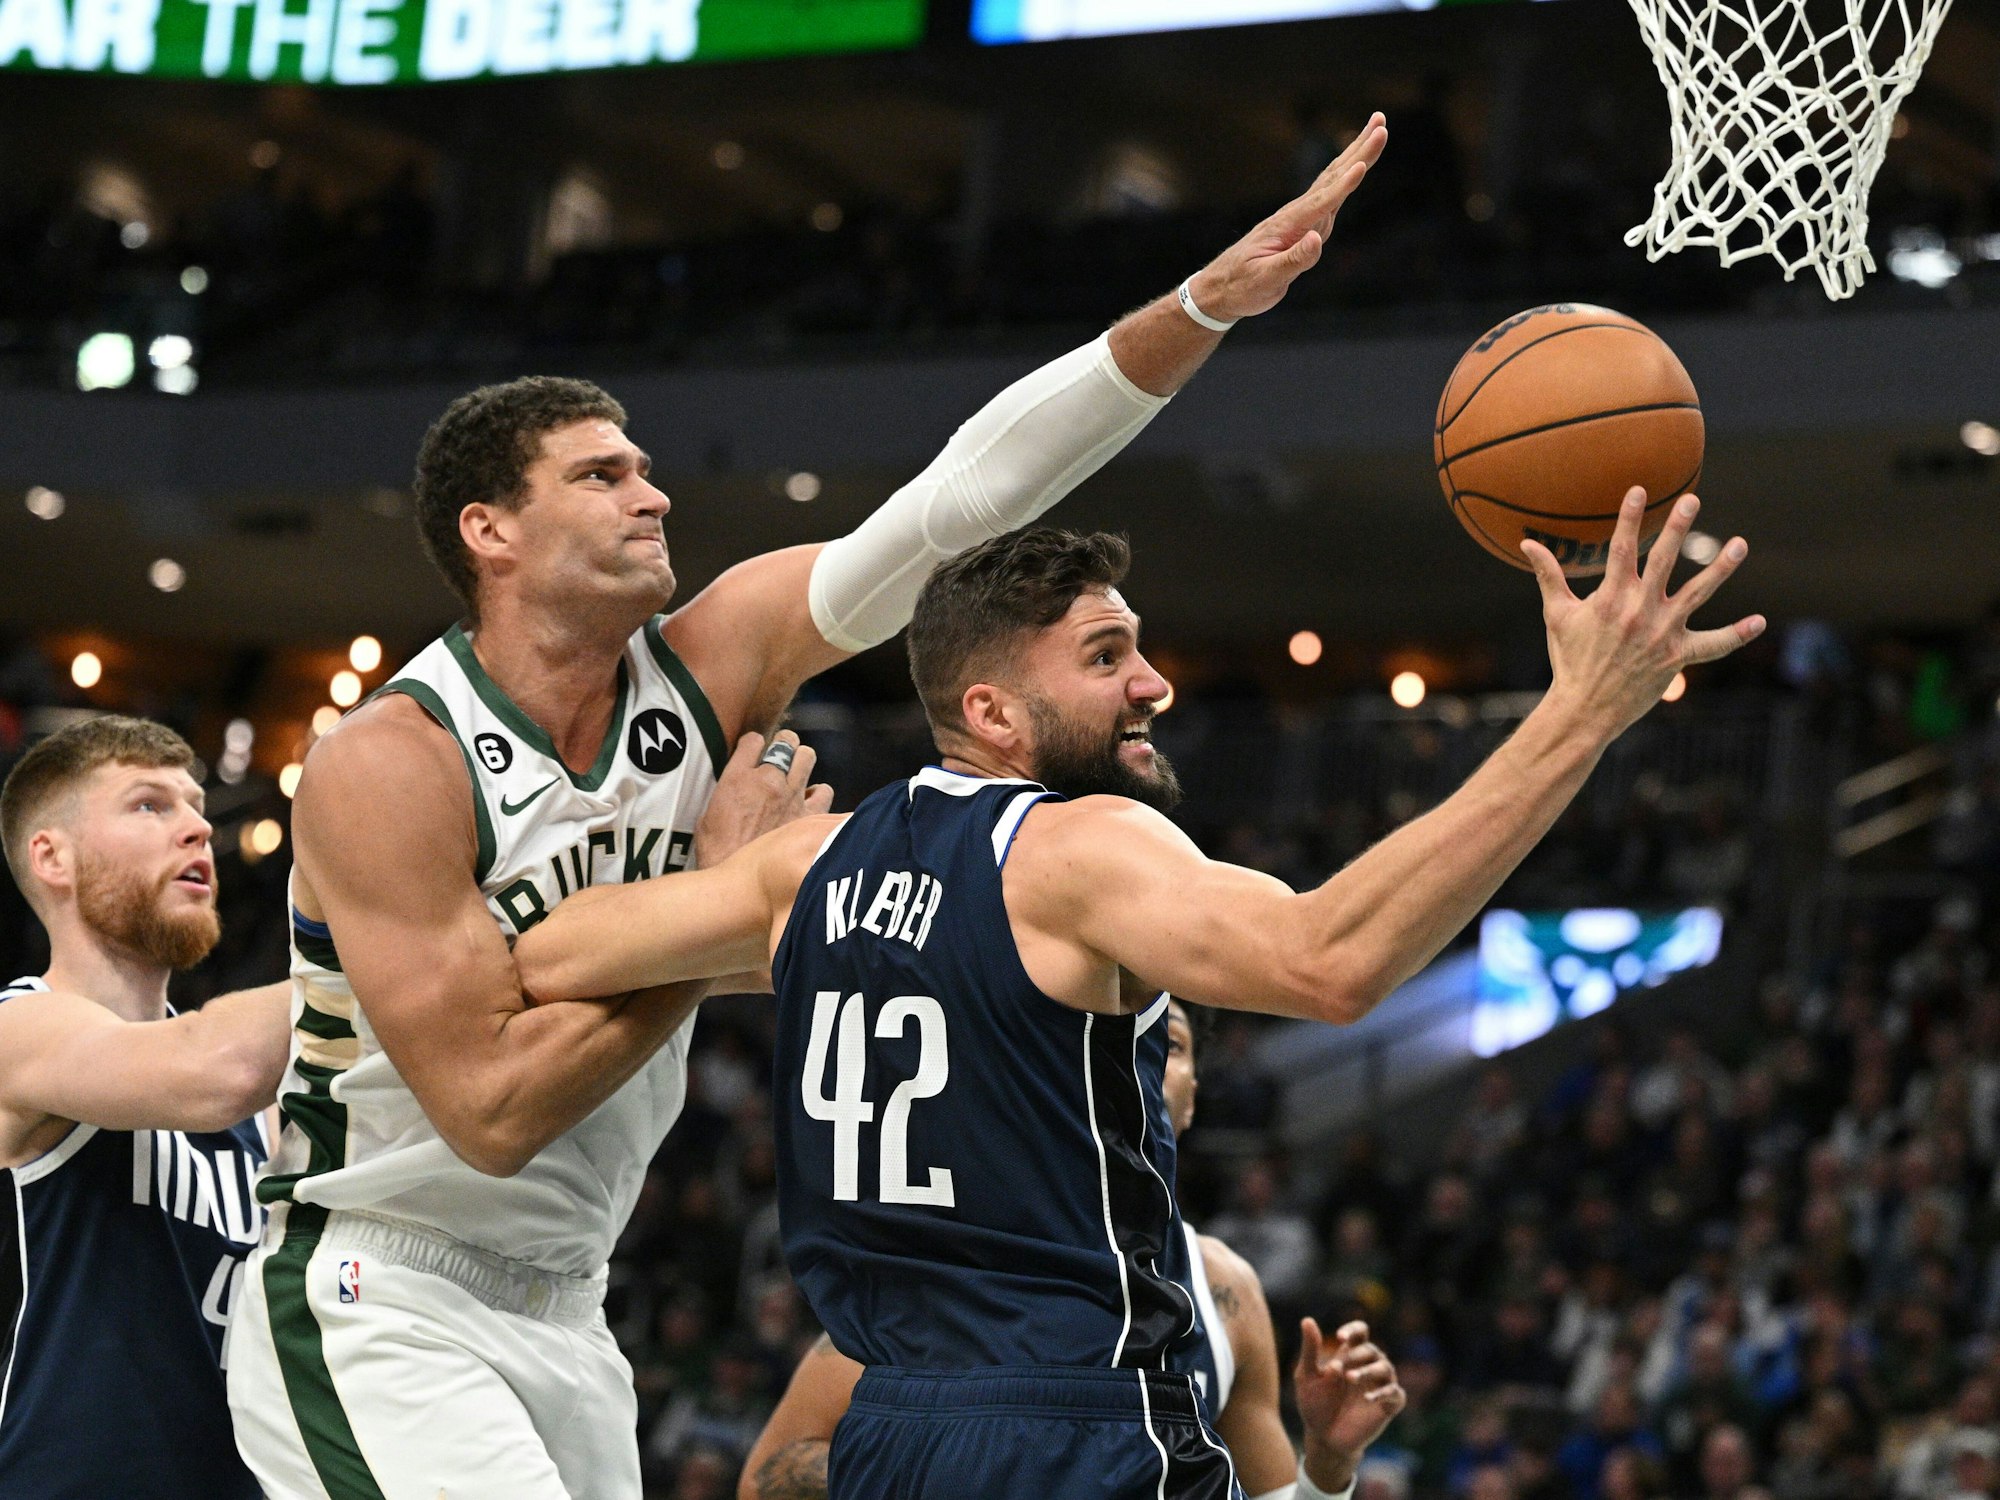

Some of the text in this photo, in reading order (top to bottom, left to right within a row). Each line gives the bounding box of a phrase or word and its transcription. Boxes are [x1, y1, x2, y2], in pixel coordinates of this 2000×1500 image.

[190, 0, 400, 85] THE
[418, 0, 700, 81] DEER
[477, 738, 505, 769] 6
[826, 868, 943, 952] KLEBER
[801, 991, 956, 1208] 42
